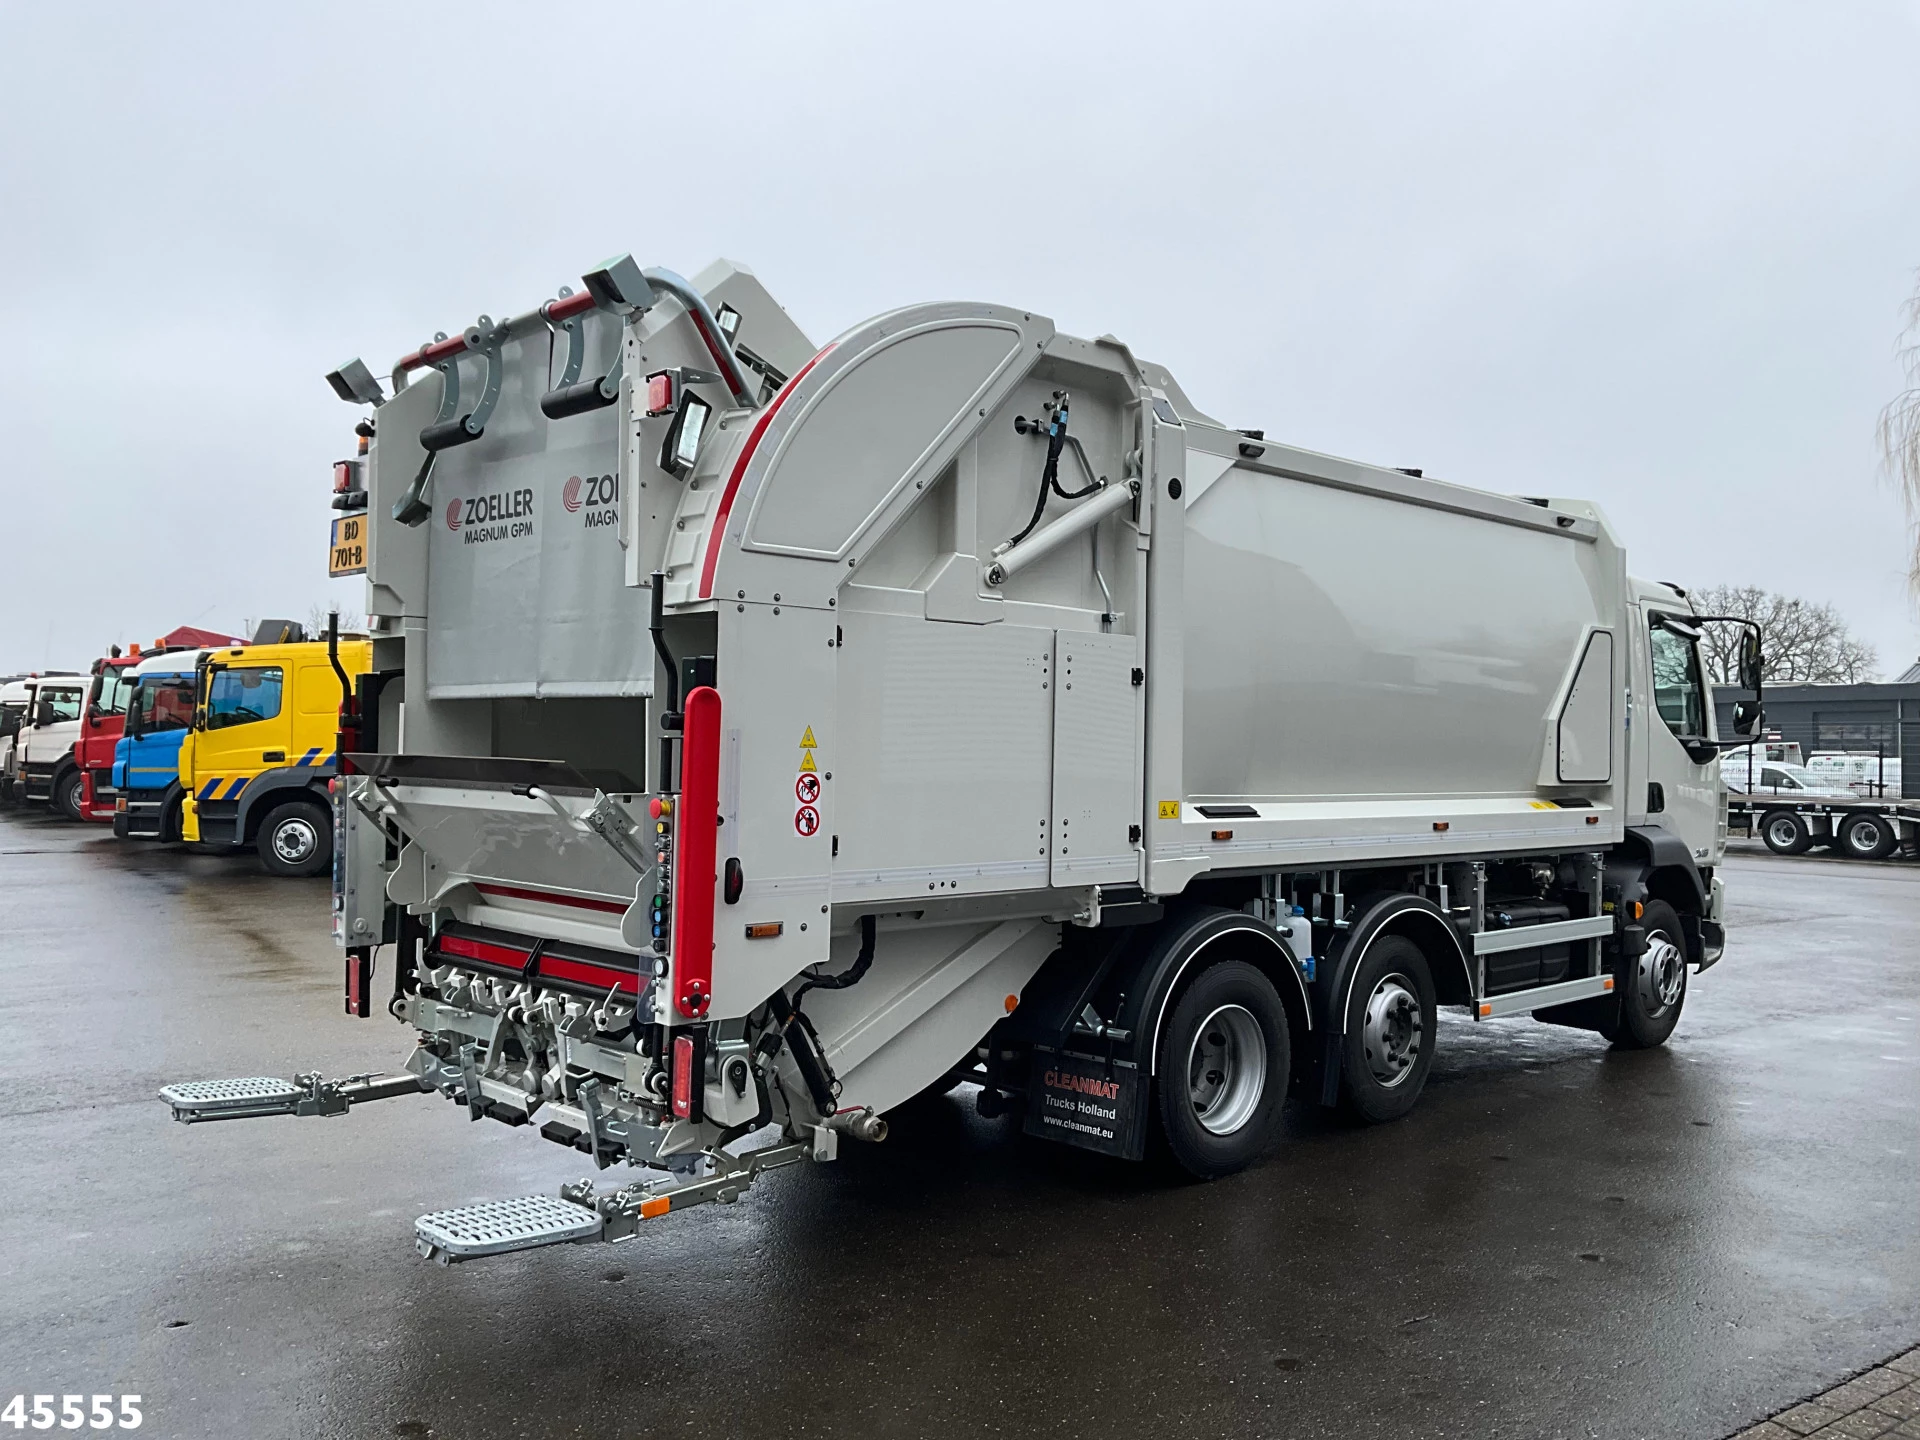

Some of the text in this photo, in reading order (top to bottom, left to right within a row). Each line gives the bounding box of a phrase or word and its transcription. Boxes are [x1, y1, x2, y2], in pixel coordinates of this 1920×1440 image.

[465, 488, 533, 525] ZOELLER
[344, 520, 359, 541] BD
[464, 521, 533, 545] MAGNUM GPM
[335, 545, 362, 568] 701-B
[1044, 1070, 1120, 1100] CLEANMAT
[1045, 1094, 1116, 1120] Trucks Holland
[1043, 1115, 1114, 1139] www.cleanmat.eu
